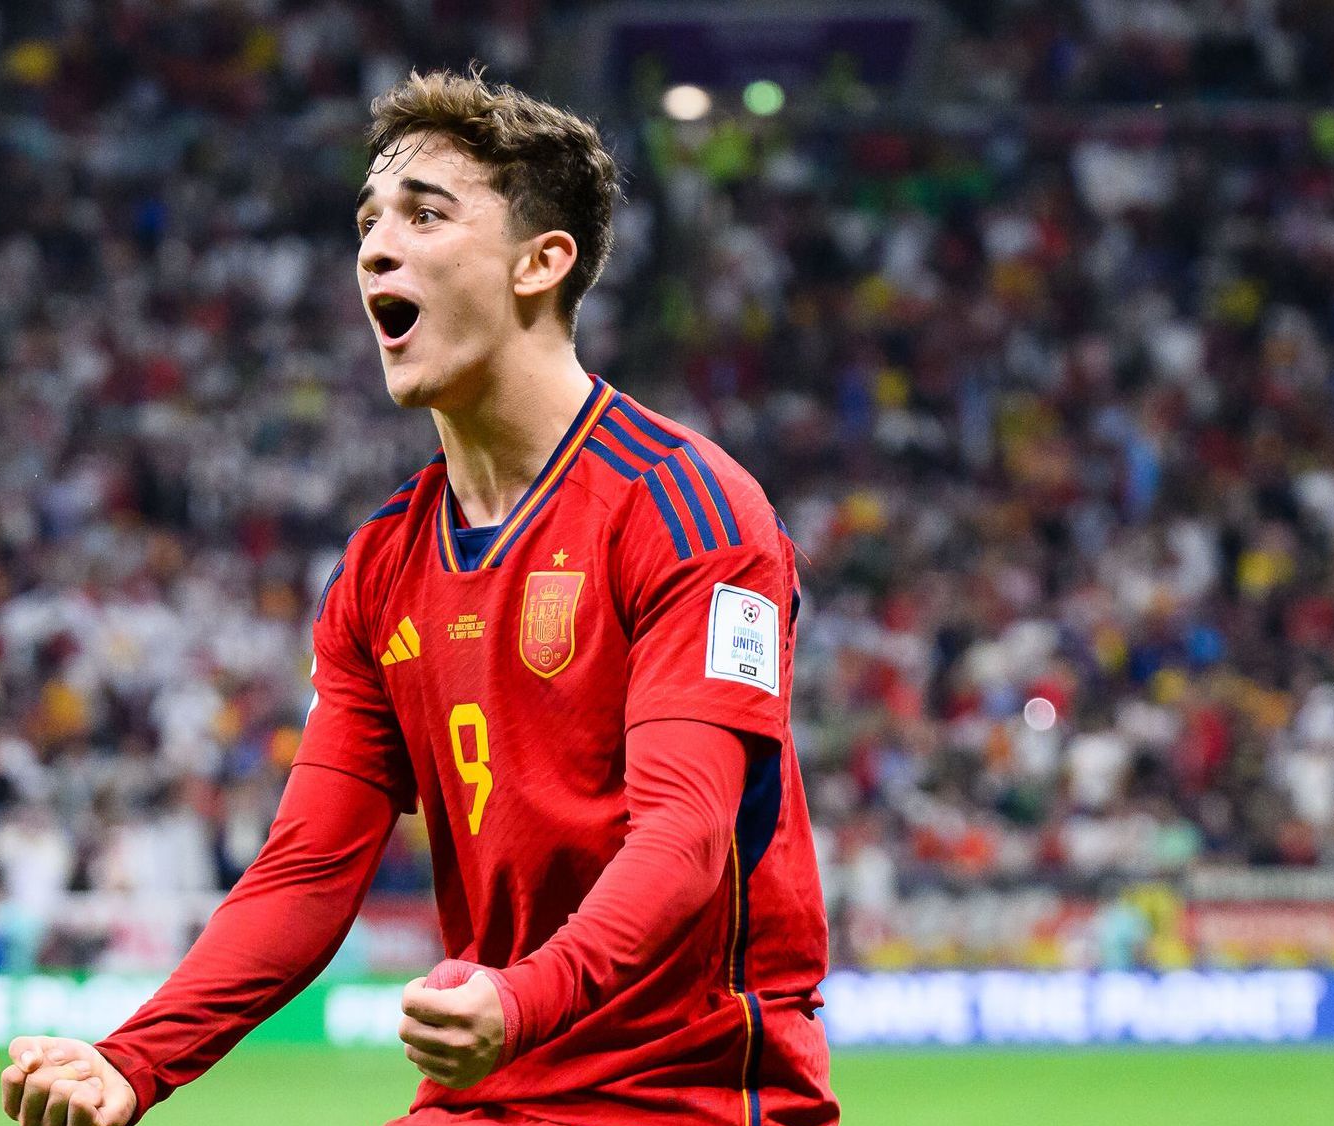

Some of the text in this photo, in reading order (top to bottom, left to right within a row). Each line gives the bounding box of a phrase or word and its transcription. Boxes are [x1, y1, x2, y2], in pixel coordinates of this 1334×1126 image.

[732, 635, 764, 656] UNITES
[740, 665, 756, 675] FIFA
[448, 703, 494, 836] 9
